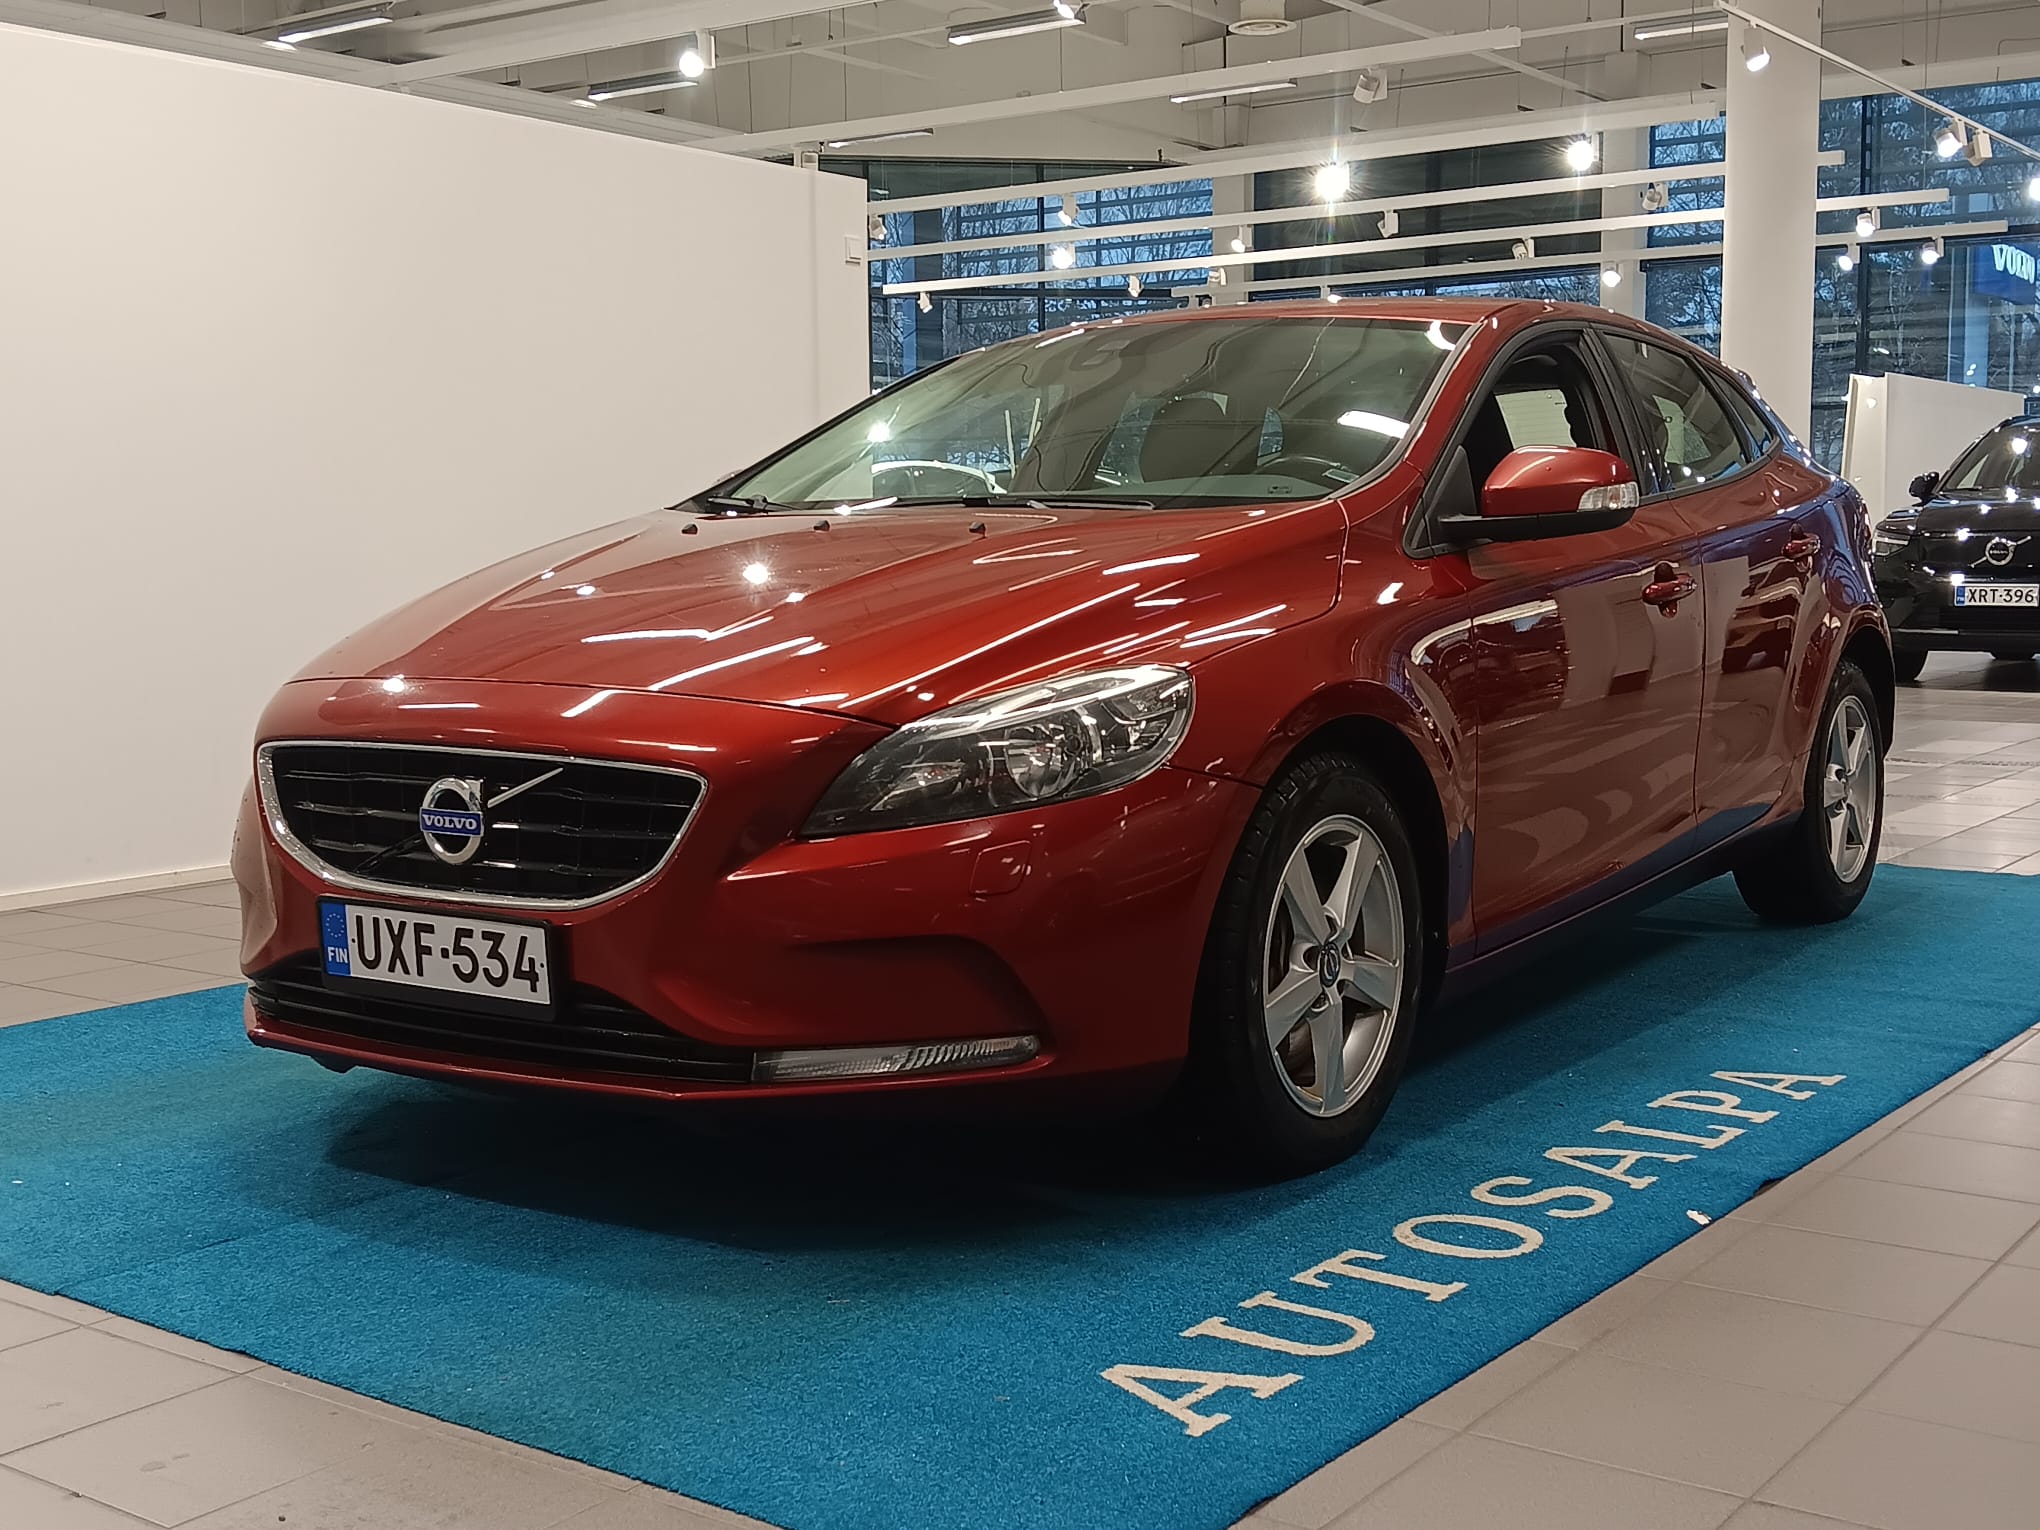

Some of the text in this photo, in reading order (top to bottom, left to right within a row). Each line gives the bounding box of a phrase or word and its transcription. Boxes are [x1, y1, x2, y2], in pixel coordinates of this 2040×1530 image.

[1968, 588, 2034, 603] XRT-396
[422, 814, 477, 830] VOLVO
[327, 914, 540, 993] FIN UXF-534
[1100, 1069, 1847, 1437] AUTOSALPA
